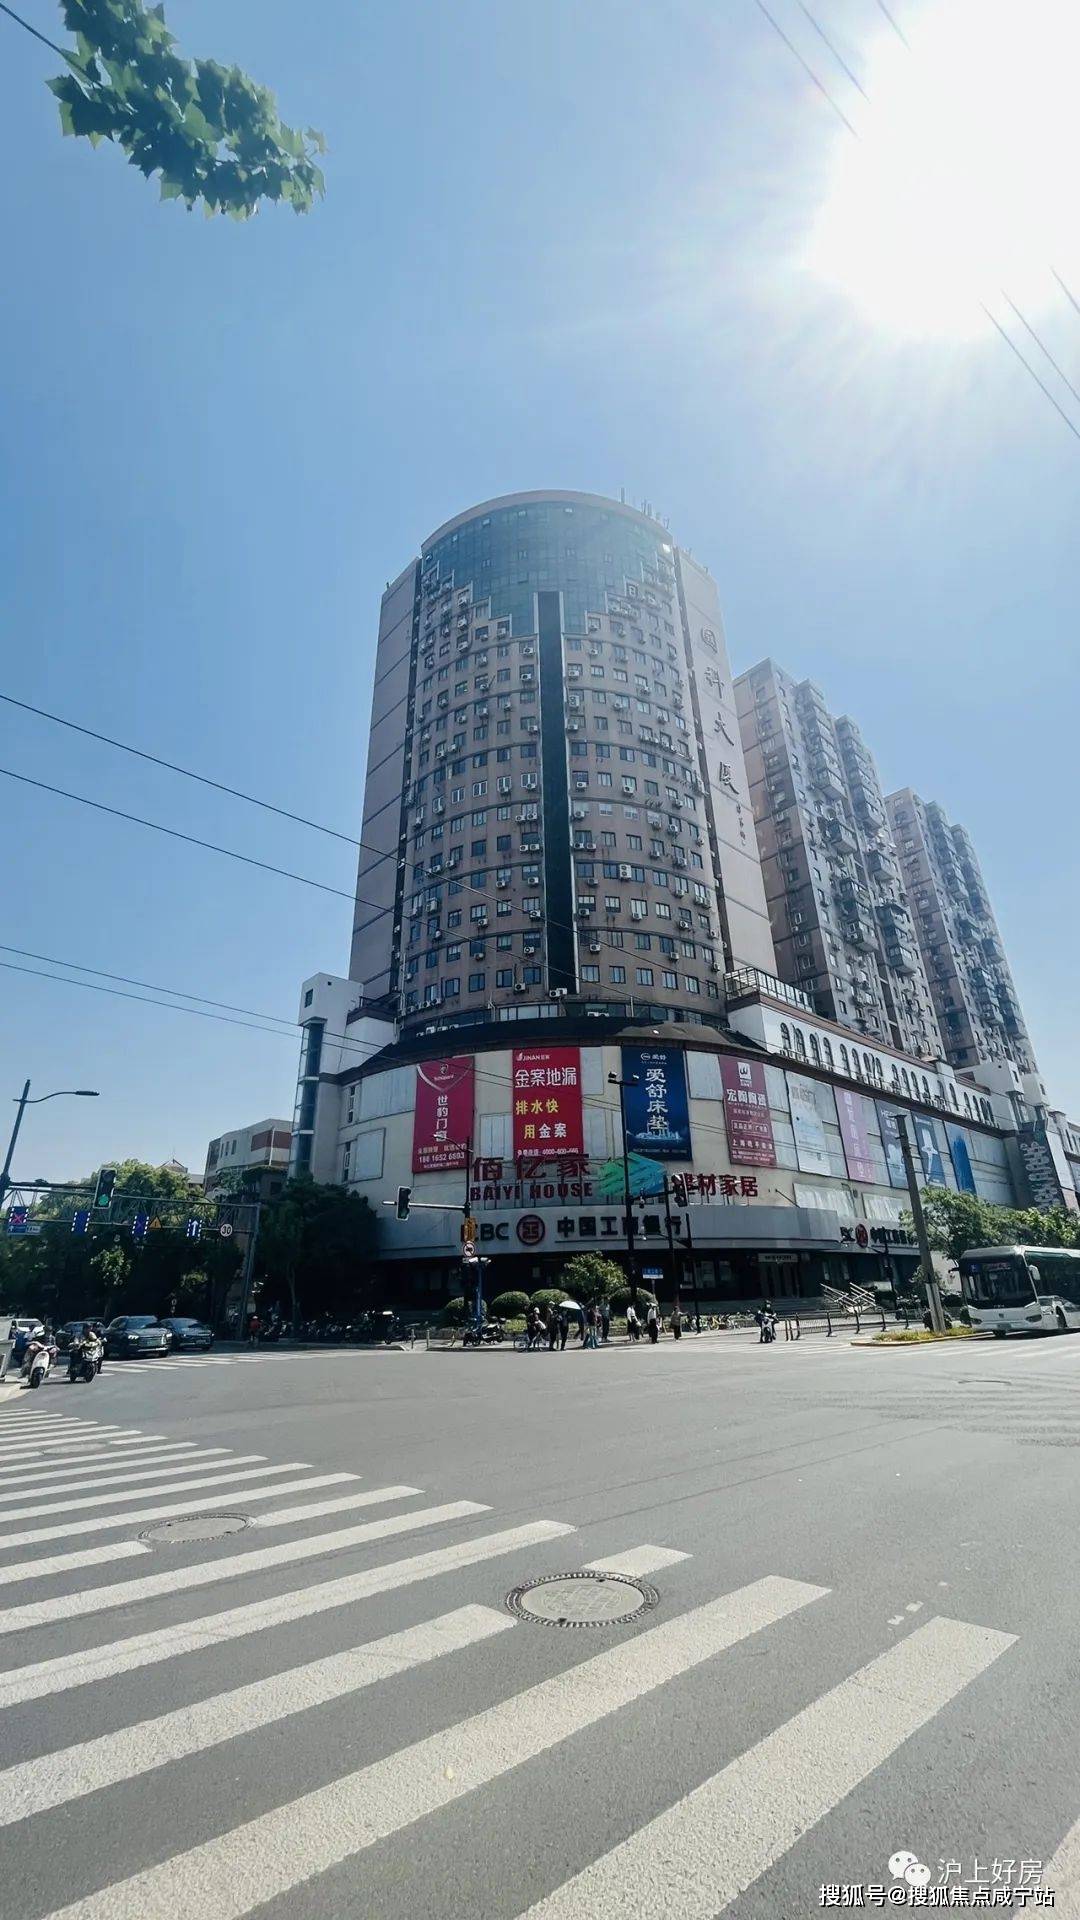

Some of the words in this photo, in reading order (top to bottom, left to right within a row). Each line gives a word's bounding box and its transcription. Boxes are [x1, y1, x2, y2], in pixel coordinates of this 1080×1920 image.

[515, 1067, 577, 1088] 金案地漏
[515, 1099, 560, 1115] 排水快
[645, 1068, 668, 1130] 爱舒床垫
[524, 1123, 567, 1139] 用金案
[472, 1153, 591, 1182] 佰亿家
[470, 1184, 521, 1201] BAIYI
[529, 1182, 593, 1199] HOUSE
[460, 1222, 510, 1242] IBC
[557, 1215, 682, 1238] 中国工商行
